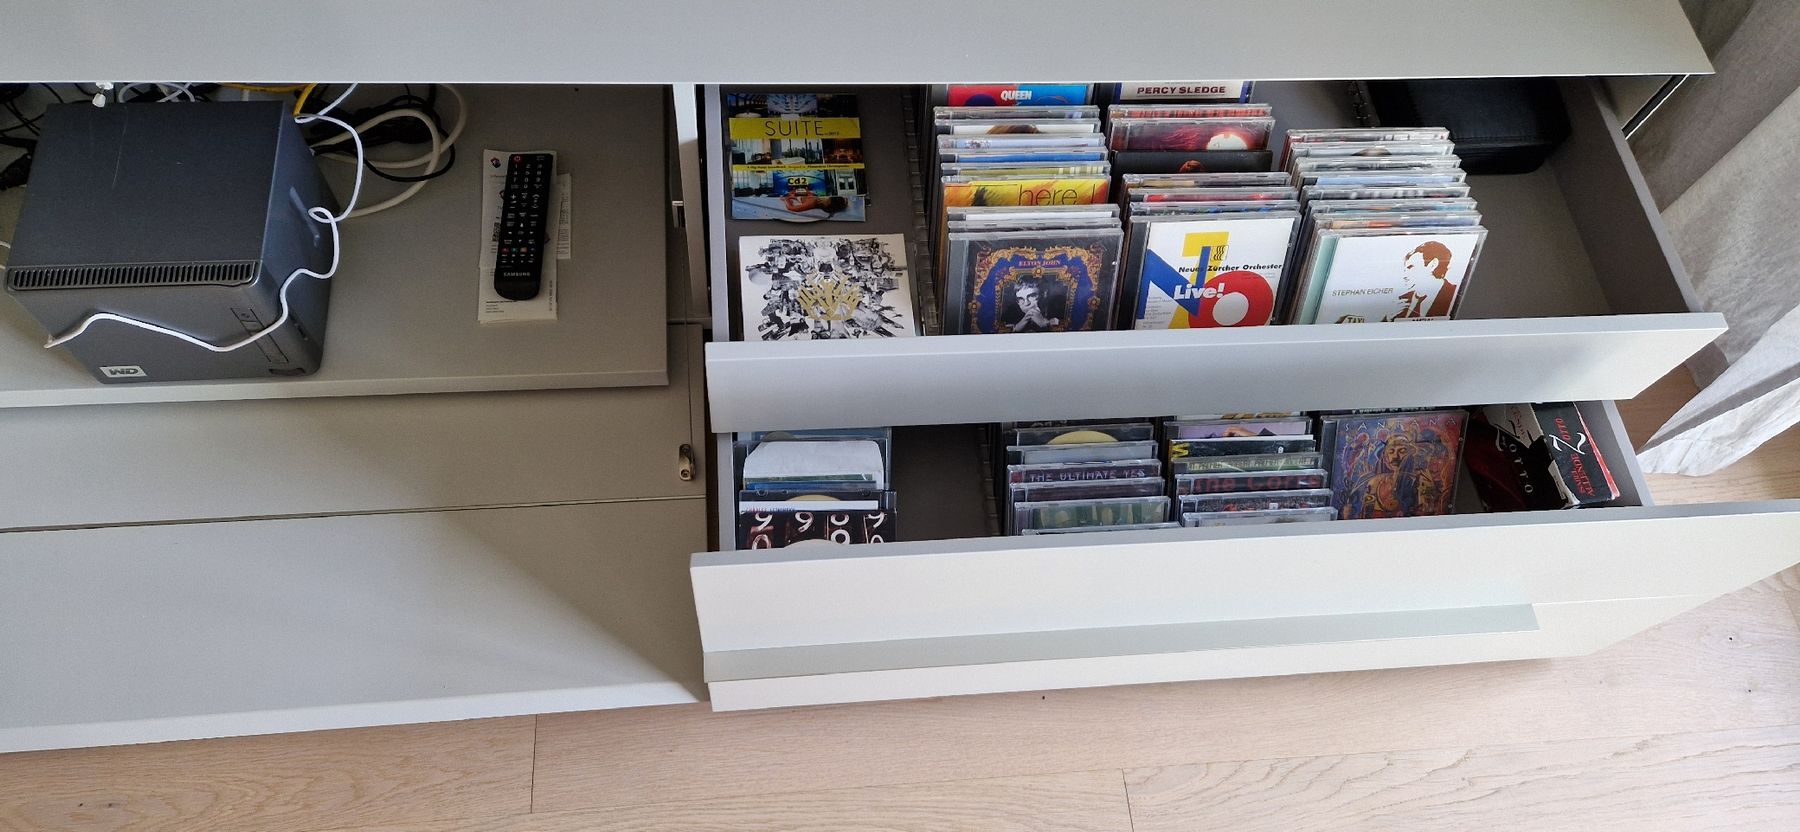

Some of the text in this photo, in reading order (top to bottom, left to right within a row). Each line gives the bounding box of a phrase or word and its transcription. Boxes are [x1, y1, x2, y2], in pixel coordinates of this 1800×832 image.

[1000, 90, 1032, 100] QUEEN
[1137, 86, 1226, 95] PERCY SLEDGE
[765, 120, 824, 137] SUITE
[1018, 184, 1078, 206] here
[1243, 263, 1283, 271] Orchester
[1174, 282, 1225, 300] Live!
[1332, 287, 1394, 297] STEPHAN EICHER
[1345, 417, 1456, 432] SANTANA
[1029, 468, 1145, 482] THE ULTIMATE YES
